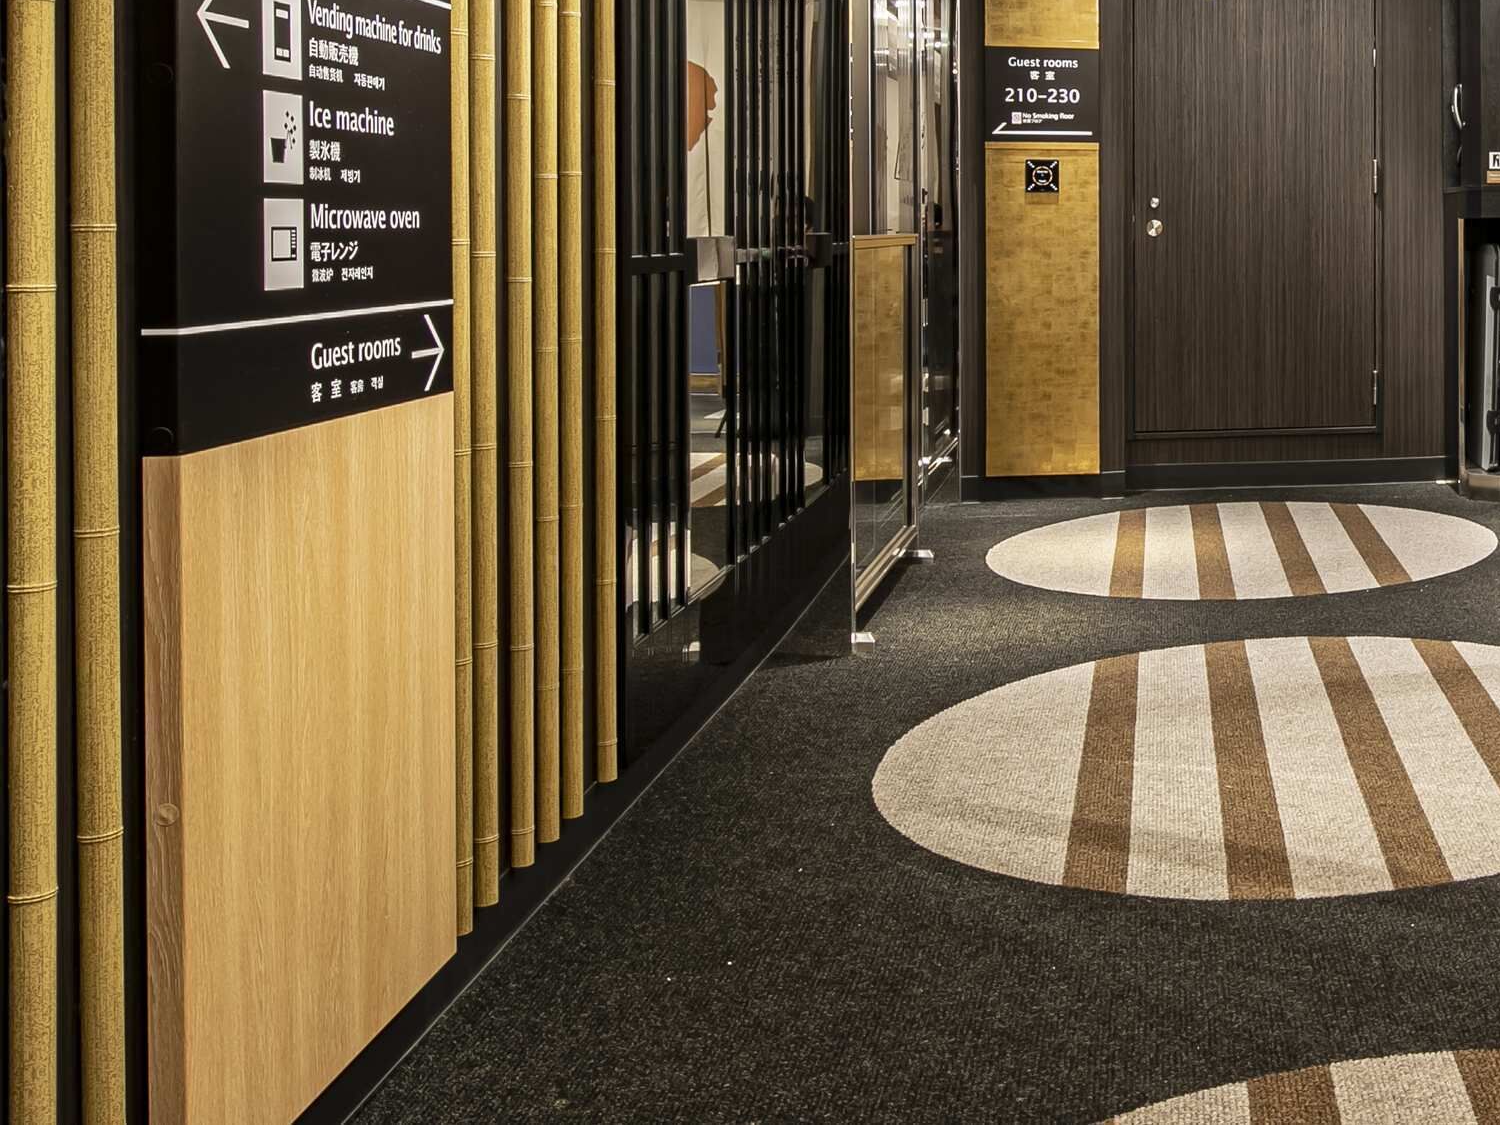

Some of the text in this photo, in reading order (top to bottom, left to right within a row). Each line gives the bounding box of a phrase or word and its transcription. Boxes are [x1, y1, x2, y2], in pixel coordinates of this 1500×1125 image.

[355, 14, 397, 44] machine
[398, 20, 413, 47] for
[414, 25, 442, 54] drinks
[309, 37, 359, 66] 自動販売機
[1008, 56, 1078, 69] Guest rooms
[1004, 87, 1080, 103] 210-230
[309, 100, 395, 136] Ice machine
[1032, 112, 1058, 121] Smoking
[1059, 112, 1075, 120] floor
[309, 139, 341, 162] 製氷機
[310, 203, 420, 229] Microwave oven
[310, 241, 359, 262] 電子レンジ
[311, 337, 401, 370] Guest rooms
